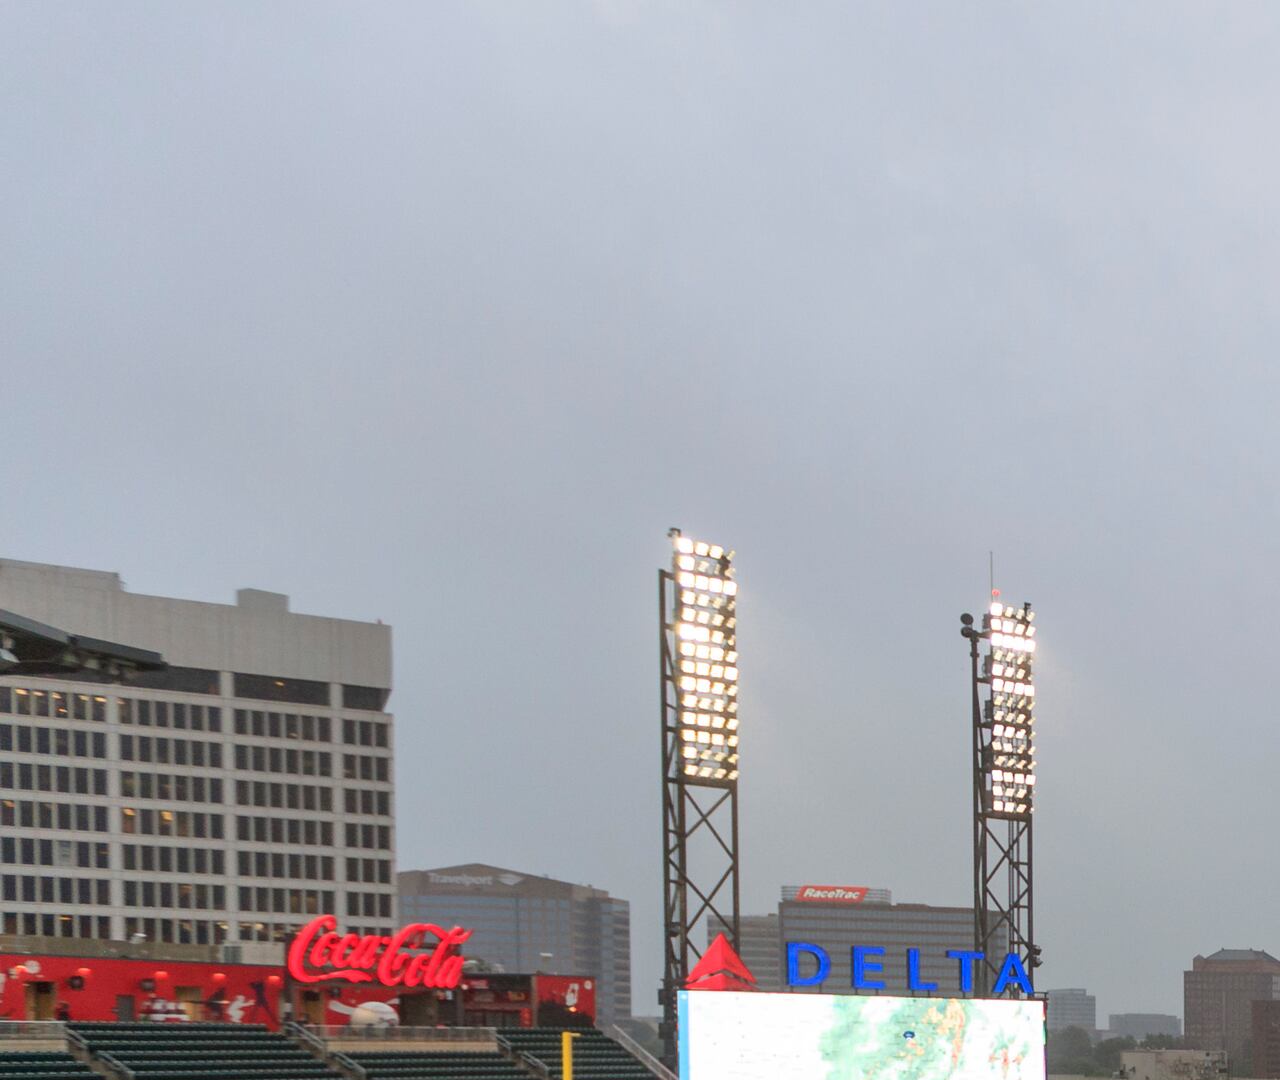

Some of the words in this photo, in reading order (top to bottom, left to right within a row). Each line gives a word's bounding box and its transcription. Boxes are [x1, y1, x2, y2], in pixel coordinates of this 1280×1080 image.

[427, 872, 493, 887] Travelport
[803, 888, 861, 900] RaceTrac
[288, 914, 473, 988] Coca-Cola
[785, 941, 1034, 993] DELTA
